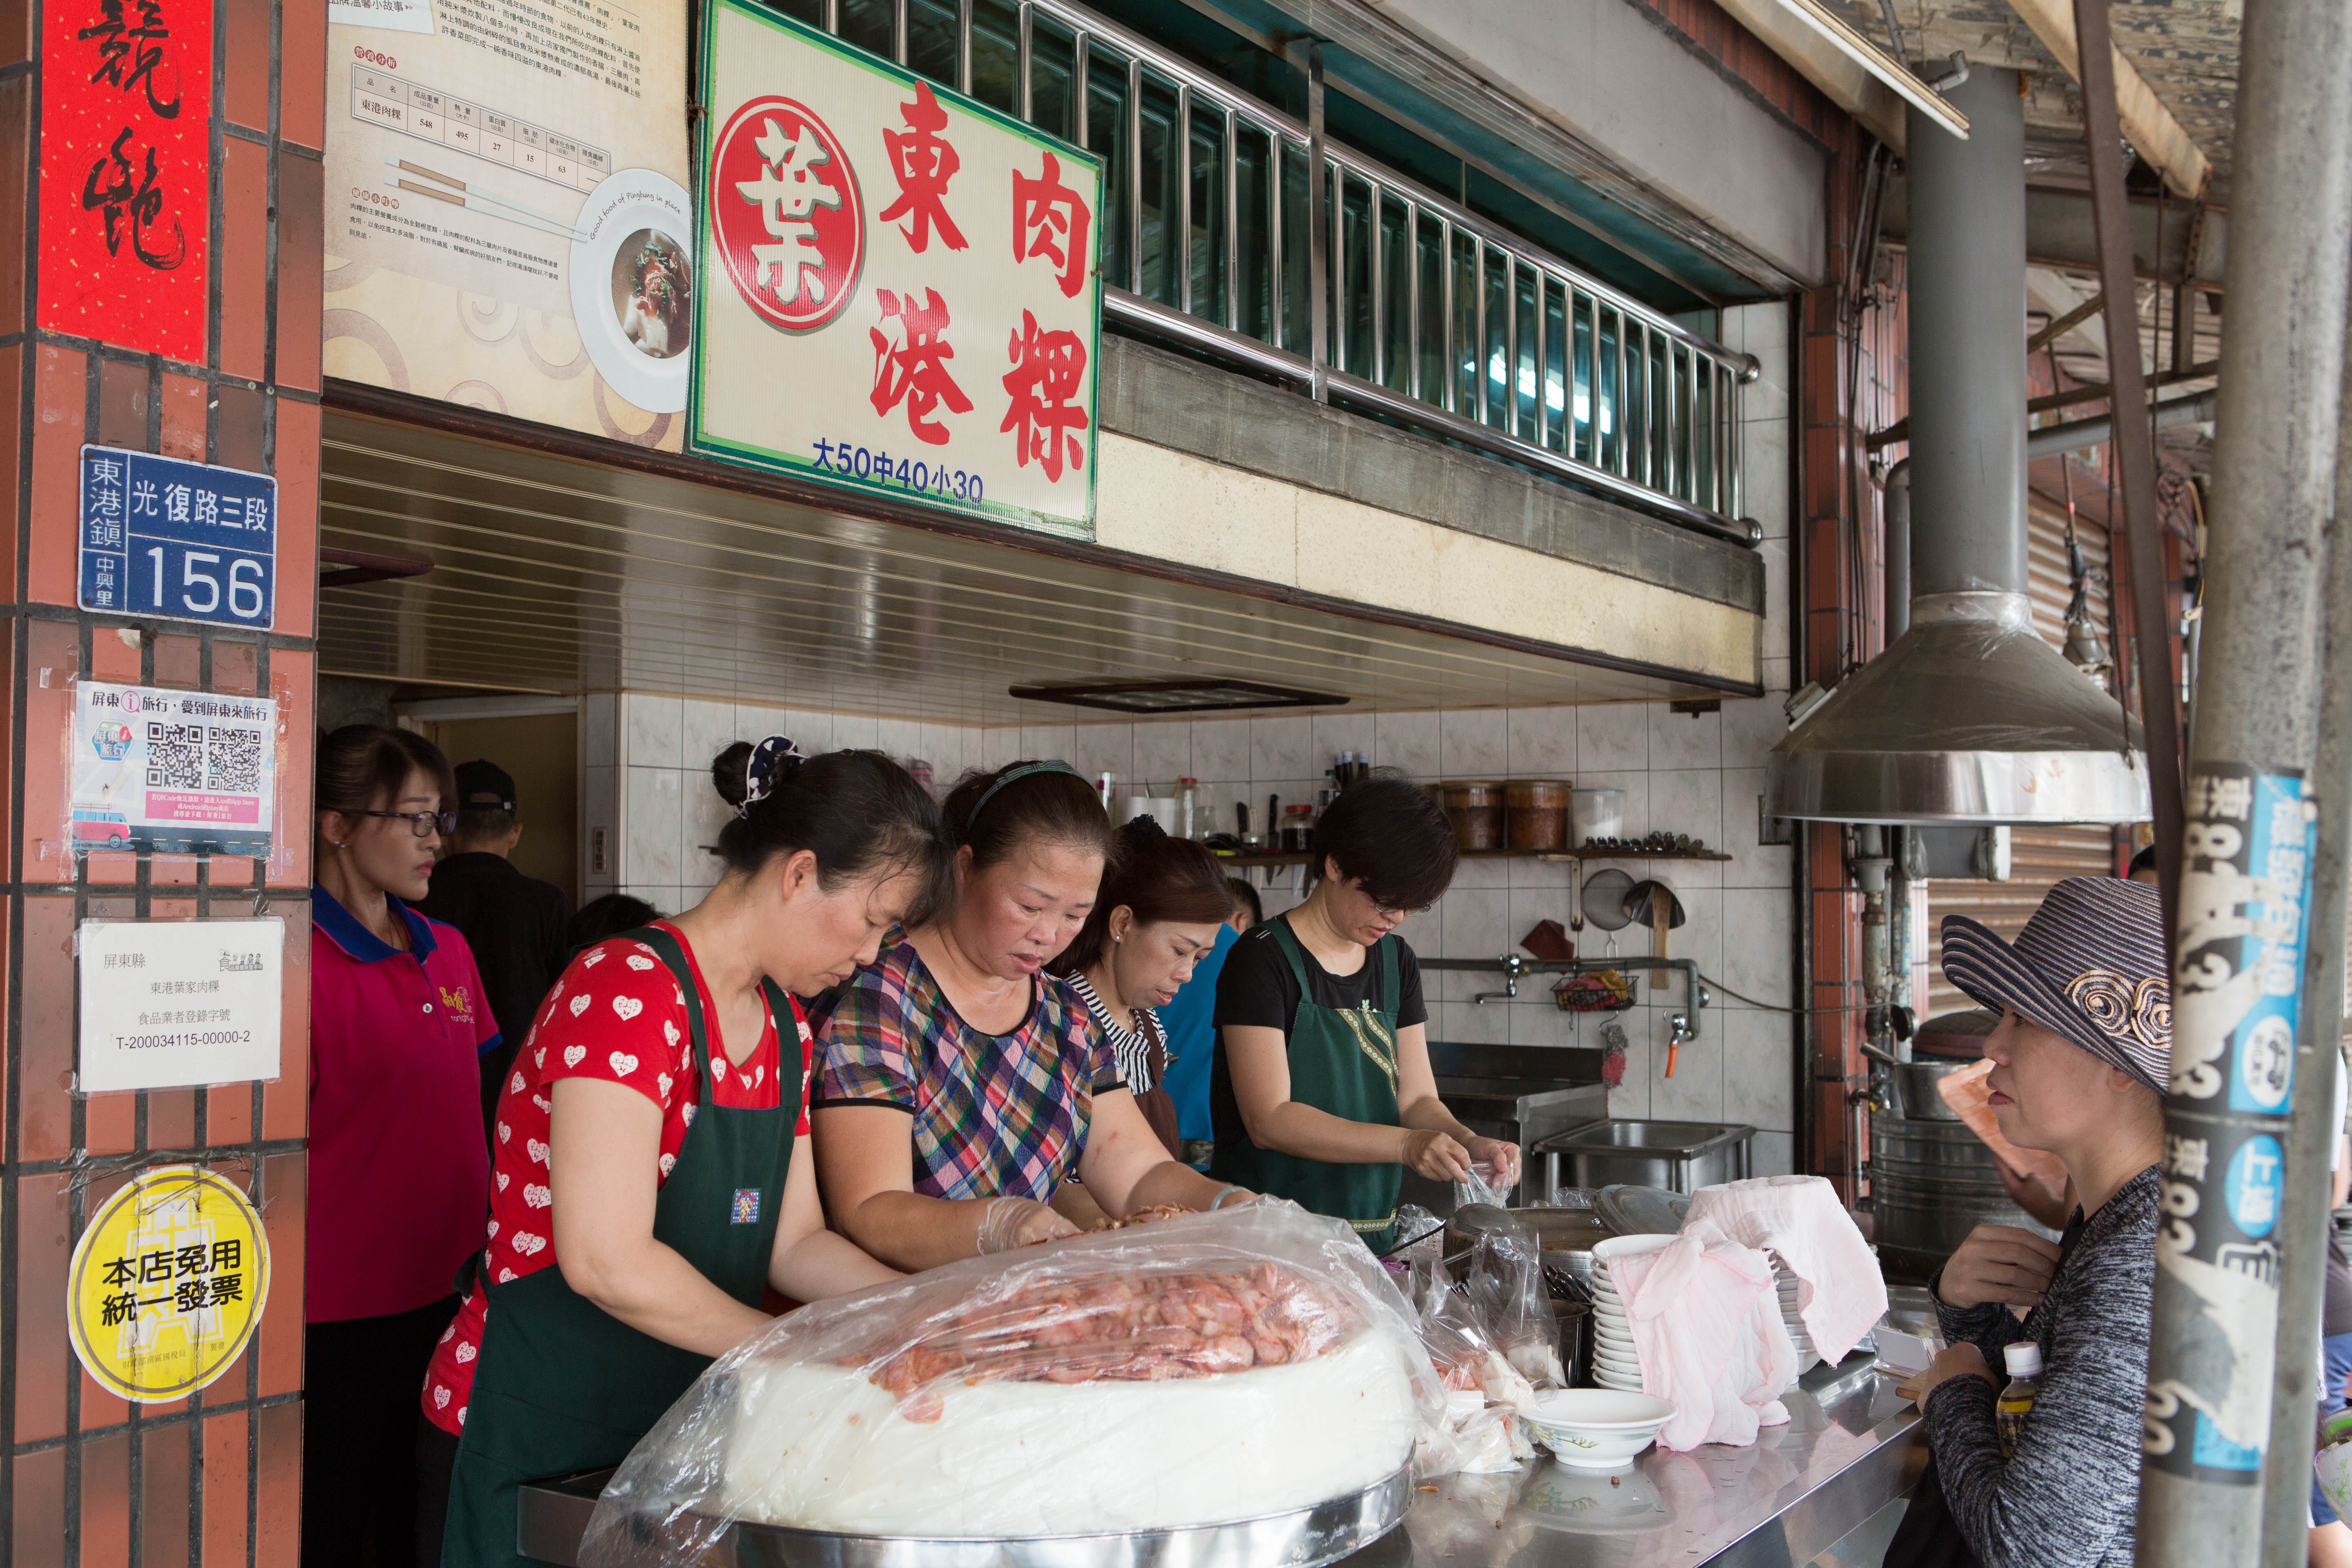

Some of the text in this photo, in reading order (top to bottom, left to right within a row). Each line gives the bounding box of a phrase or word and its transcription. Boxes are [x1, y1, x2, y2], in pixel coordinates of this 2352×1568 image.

[355, 47, 396, 68] 營養分析
[414, 91, 439, 104] 成品重量
[362, 99, 401, 120] 東港肉粿
[420, 119, 432, 128] 548
[489, 116, 506, 127] 蛋白質
[456, 131, 468, 140] 495
[550, 137, 575, 152] 碳水化合物
[590, 216, 604, 240] Good
[602, 200, 617, 218] food
[618, 193, 625, 204] of
[626, 191, 654, 201] Pingtung
[666, 200, 681, 214] place
[735, 116, 844, 306] 葉
[870, 80, 974, 445] 東港
[1000, 150, 1091, 483] 肉粿
[813, 437, 983, 504] 大50中40小30
[133, 480, 267, 532] 光復路三段
[95, 557, 114, 606] 中興里
[148, 546, 264, 618] 156
[104, 953, 146, 969] 屏東縣
[150, 980, 219, 995] 東港葉家肉粿
[138, 1009, 230, 1025] 食品業者登錄字號
[116, 1030, 250, 1049] T-200034115-00000-2
[102, 1239, 240, 1288] 本店免用
[102, 1273, 243, 1327] 統一發票
